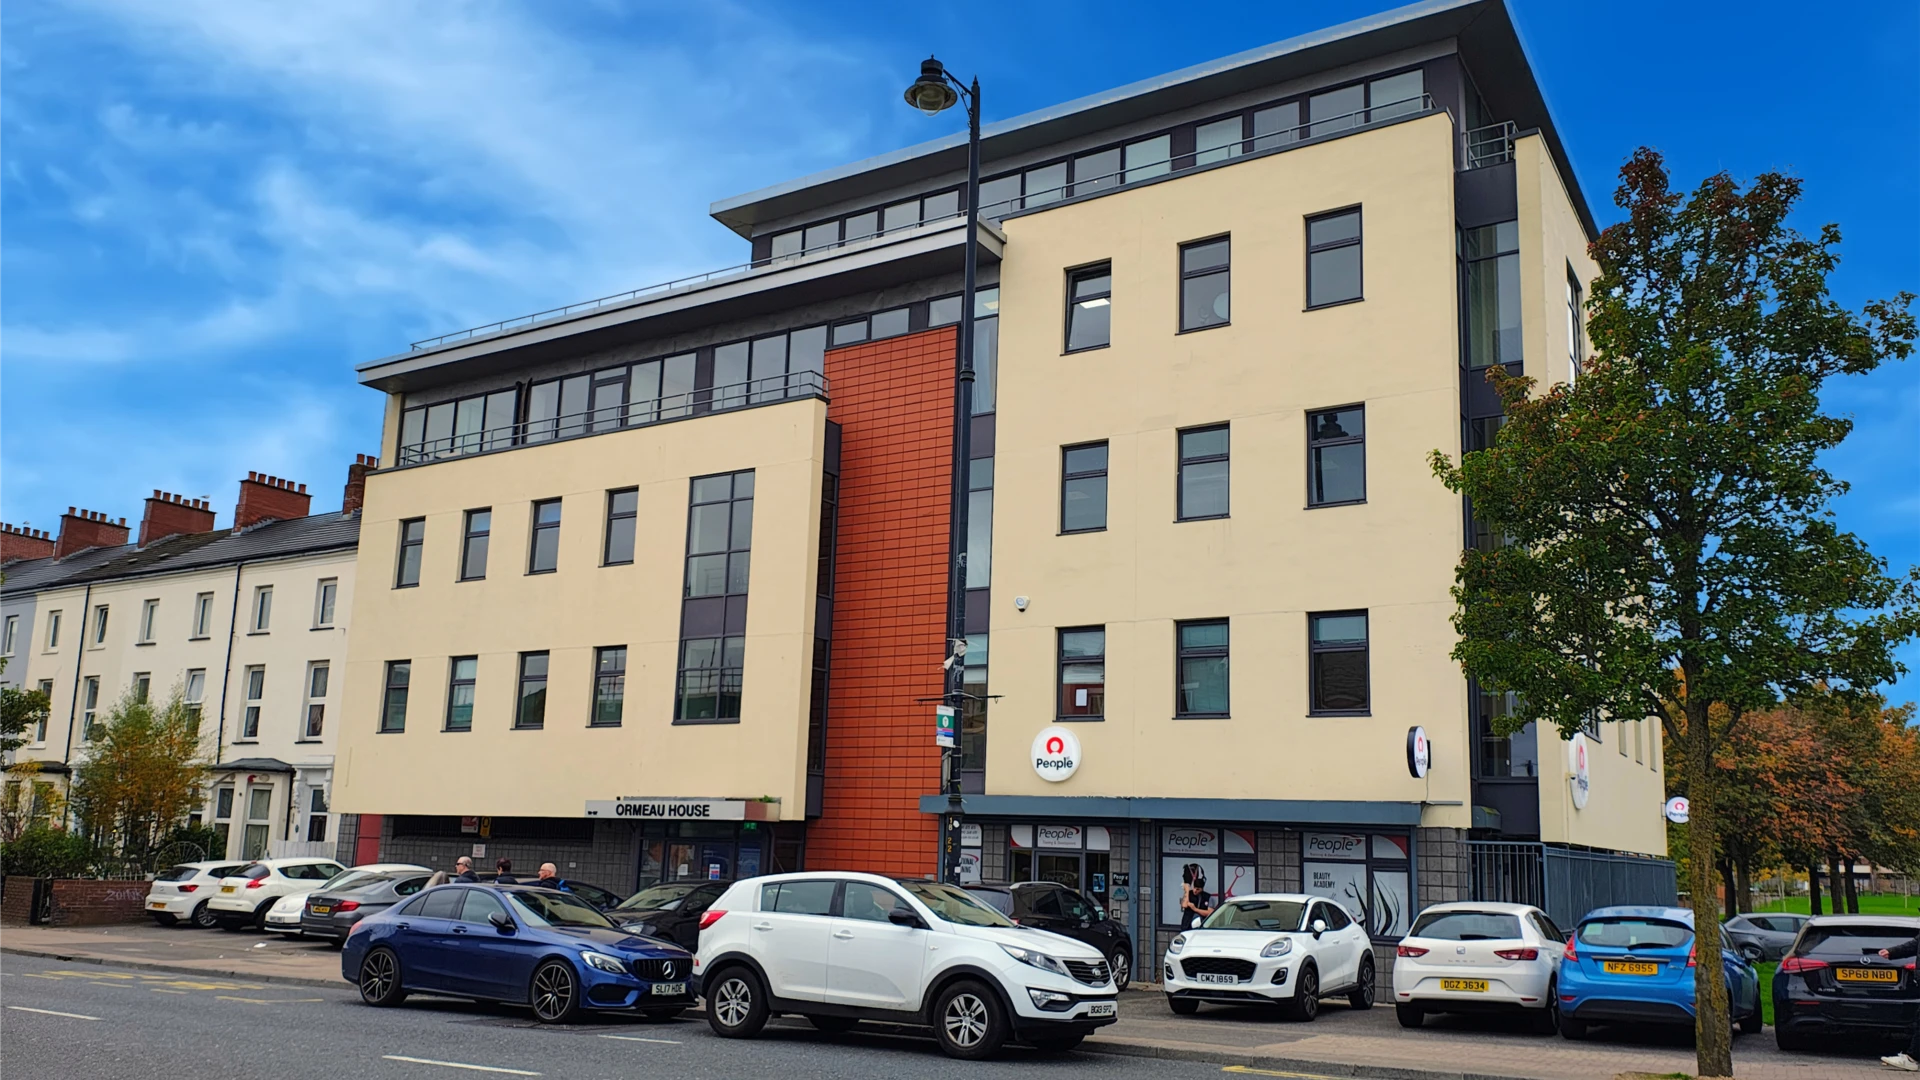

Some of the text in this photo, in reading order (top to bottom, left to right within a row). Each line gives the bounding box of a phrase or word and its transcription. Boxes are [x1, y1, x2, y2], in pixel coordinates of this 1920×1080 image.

[1036, 756, 1073, 771] People
[615, 803, 711, 817] ORMEAU HOUSE
[1039, 827, 1074, 840] People
[1168, 833, 1208, 849] People
[1309, 836, 1354, 853] People
[1313, 872, 1331, 880] BEAUTY
[1313, 880, 1336, 889] ACADEMY
[1607, 962, 1654, 973] NFZ 6955
[1200, 974, 1234, 984] CMZ 1859
[1841, 969, 1893, 980] SP68 NBO
[655, 984, 670, 994] SL17
[1444, 980, 1485, 990] DGZ 3634
